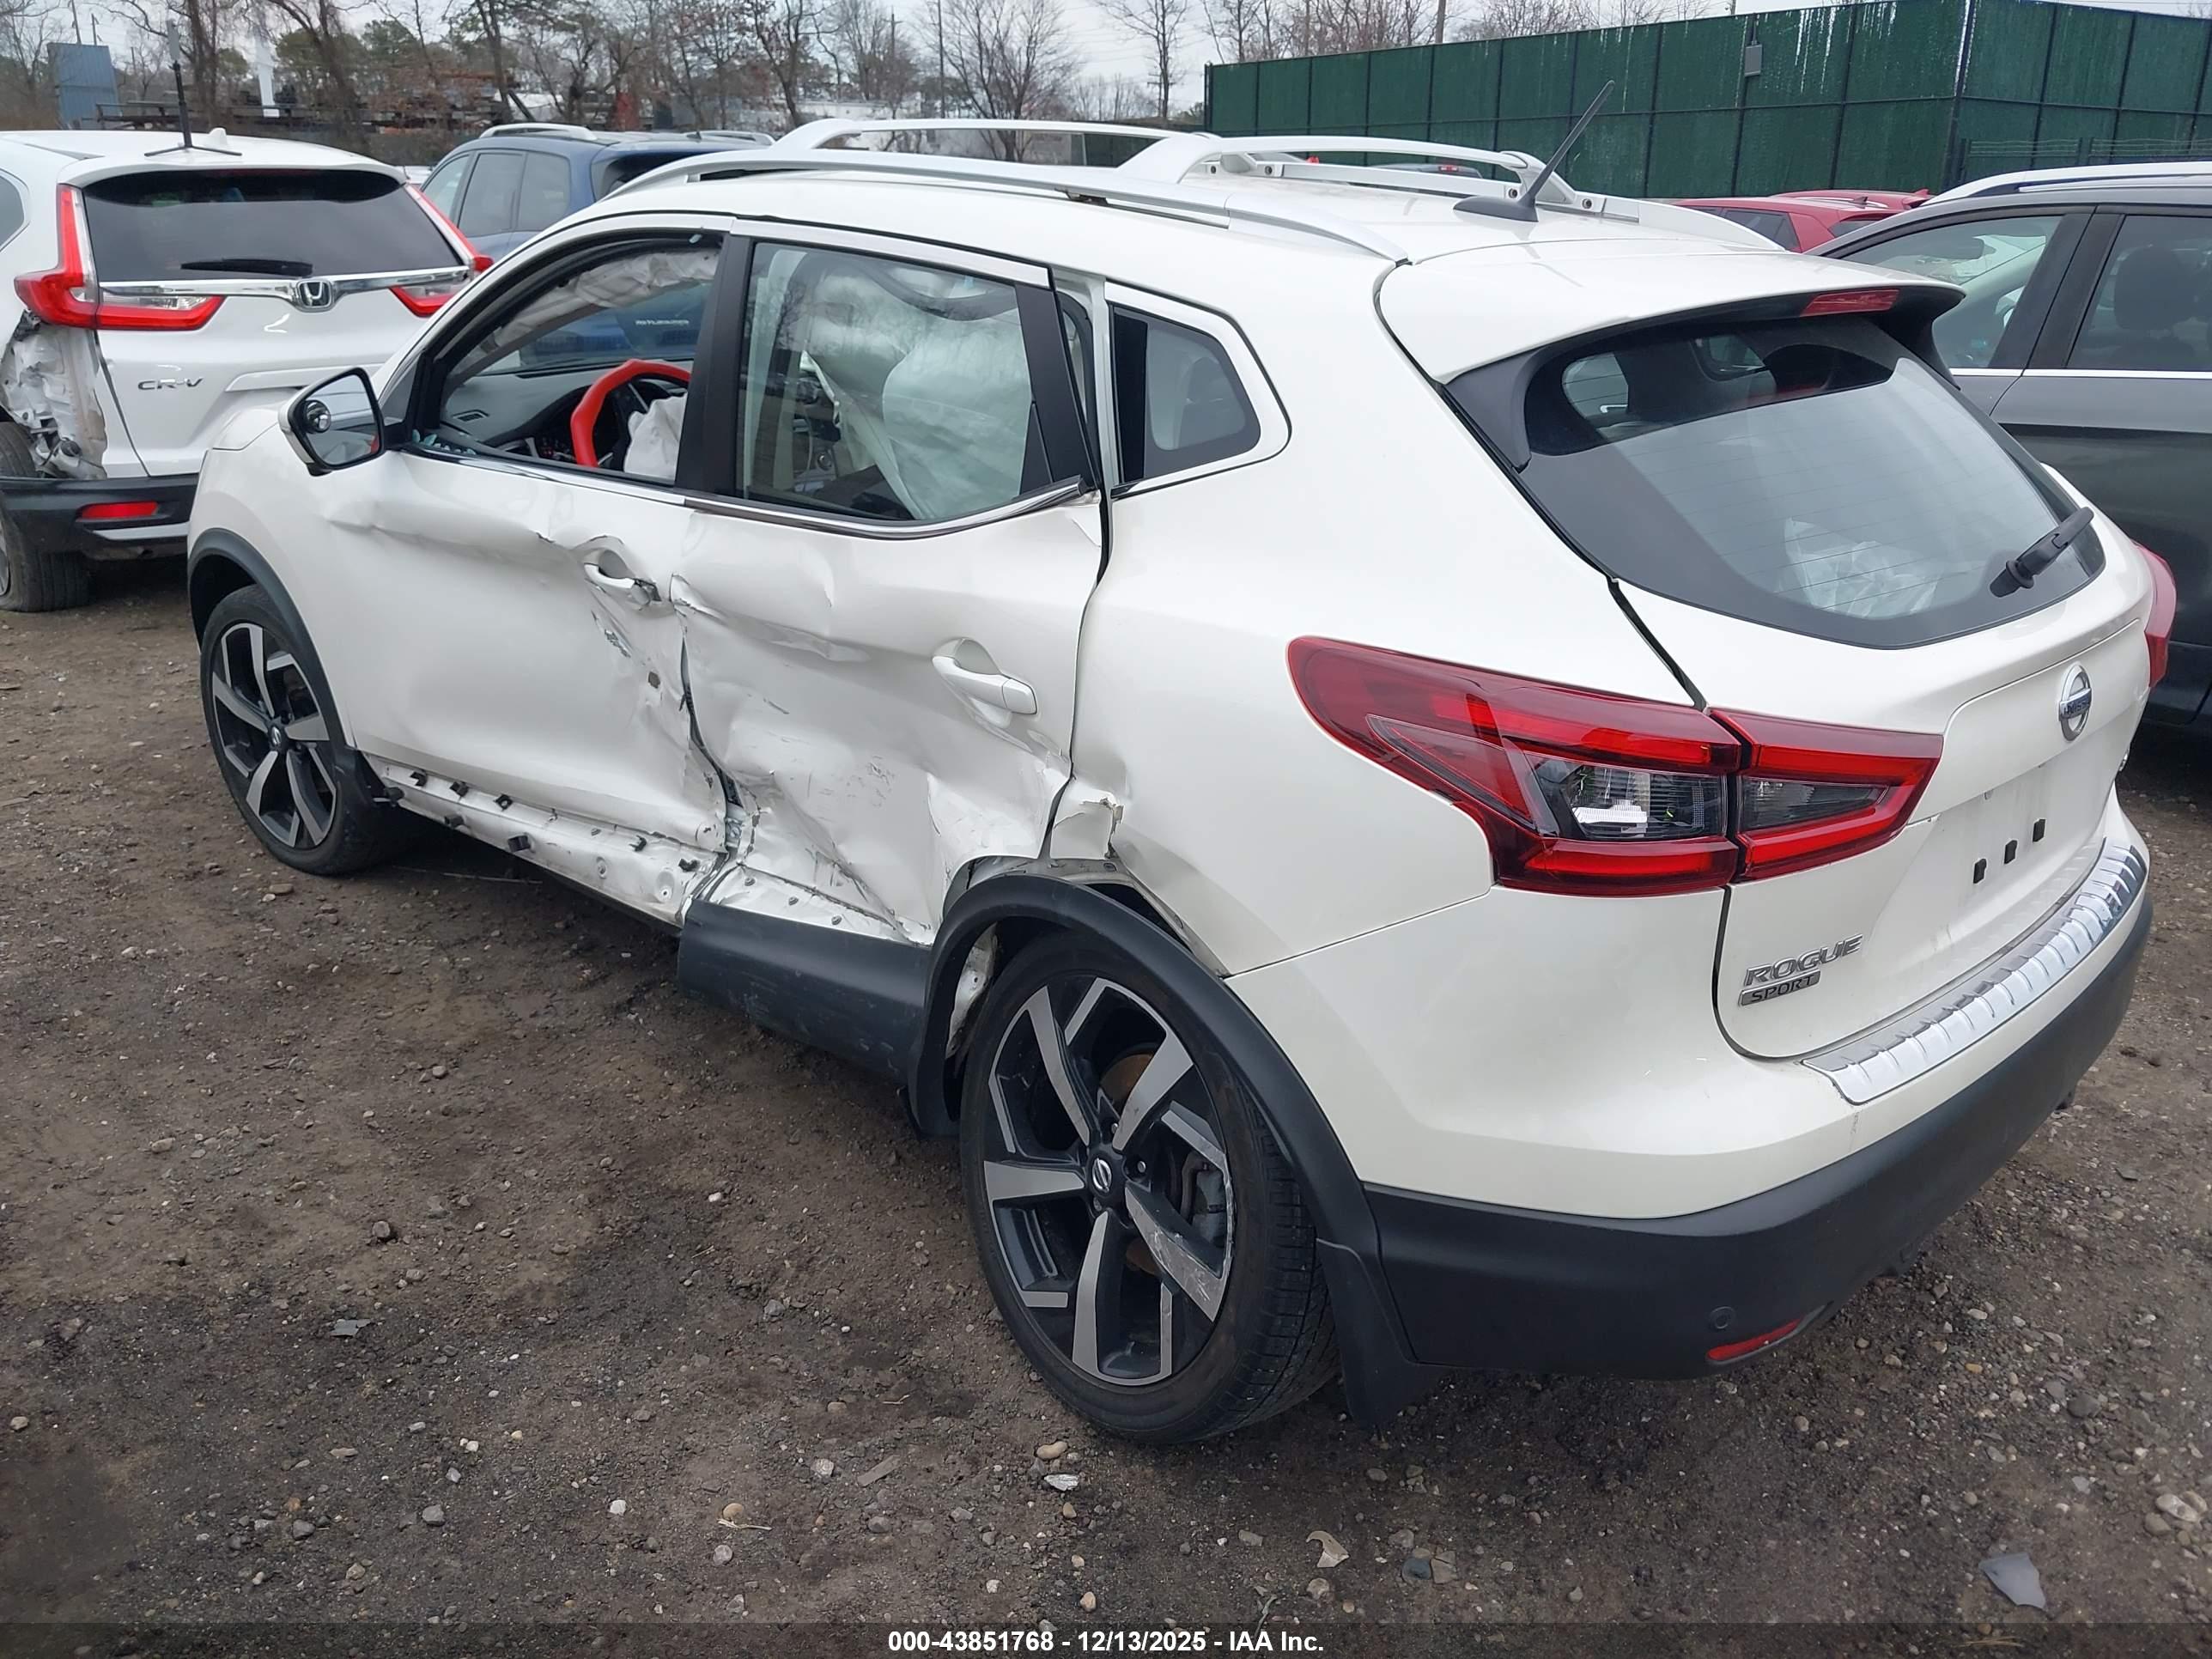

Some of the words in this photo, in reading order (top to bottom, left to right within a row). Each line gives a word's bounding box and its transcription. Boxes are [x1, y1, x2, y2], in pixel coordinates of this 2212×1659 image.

[137, 377, 204, 391] CR-V
[1743, 933, 1863, 986] ROGUE
[1750, 974, 1815, 1003] SPORT
